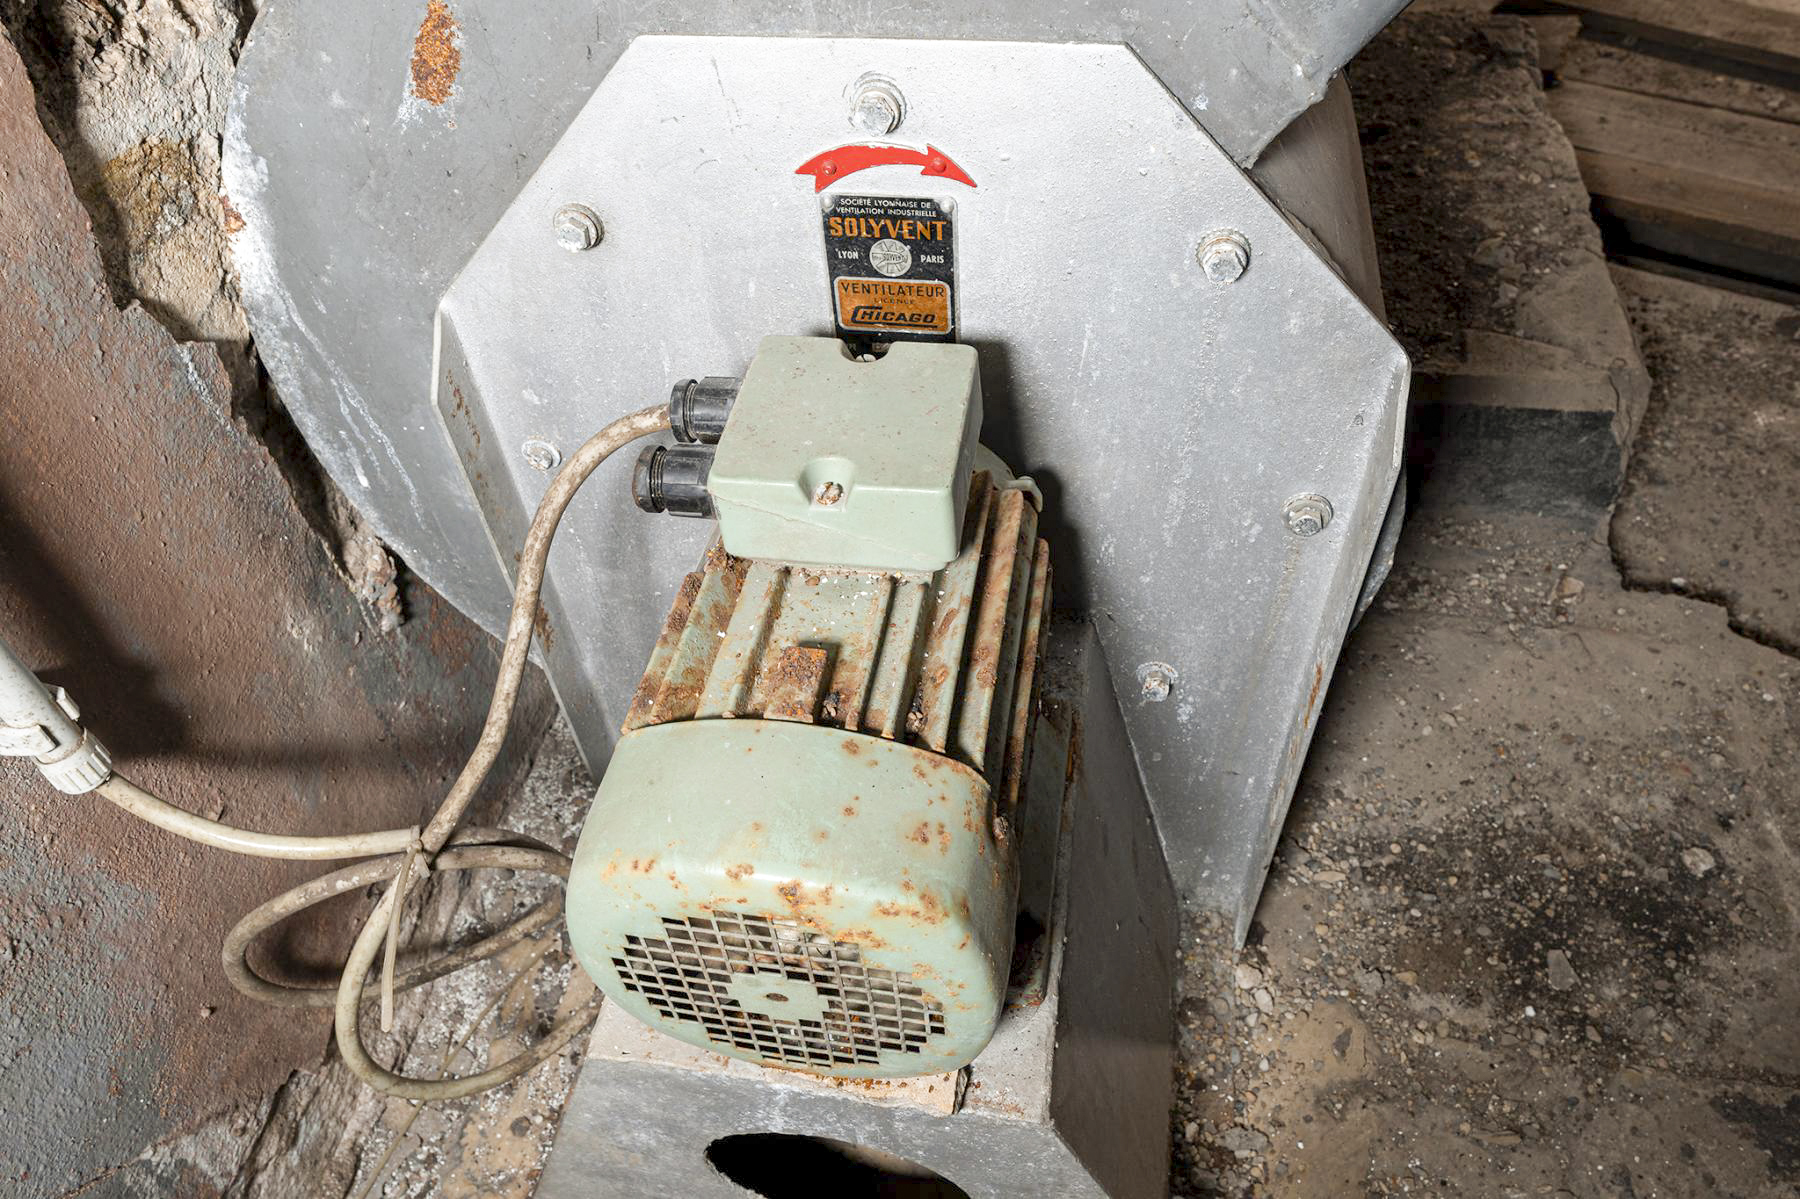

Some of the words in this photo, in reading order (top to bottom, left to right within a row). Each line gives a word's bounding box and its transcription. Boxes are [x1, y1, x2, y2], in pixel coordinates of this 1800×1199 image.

[875, 199, 918, 208] LYONNAISE
[920, 201, 931, 209] DE
[835, 207, 884, 215] VENTILATION
[888, 208, 936, 217] INDUSTRIELLE
[828, 216, 947, 240] SOLYVENT
[838, 250, 859, 260] LYON
[920, 254, 945, 264] PARIS
[841, 282, 945, 297] VENTILATEUR
[851, 306, 938, 327] CHICAGO
